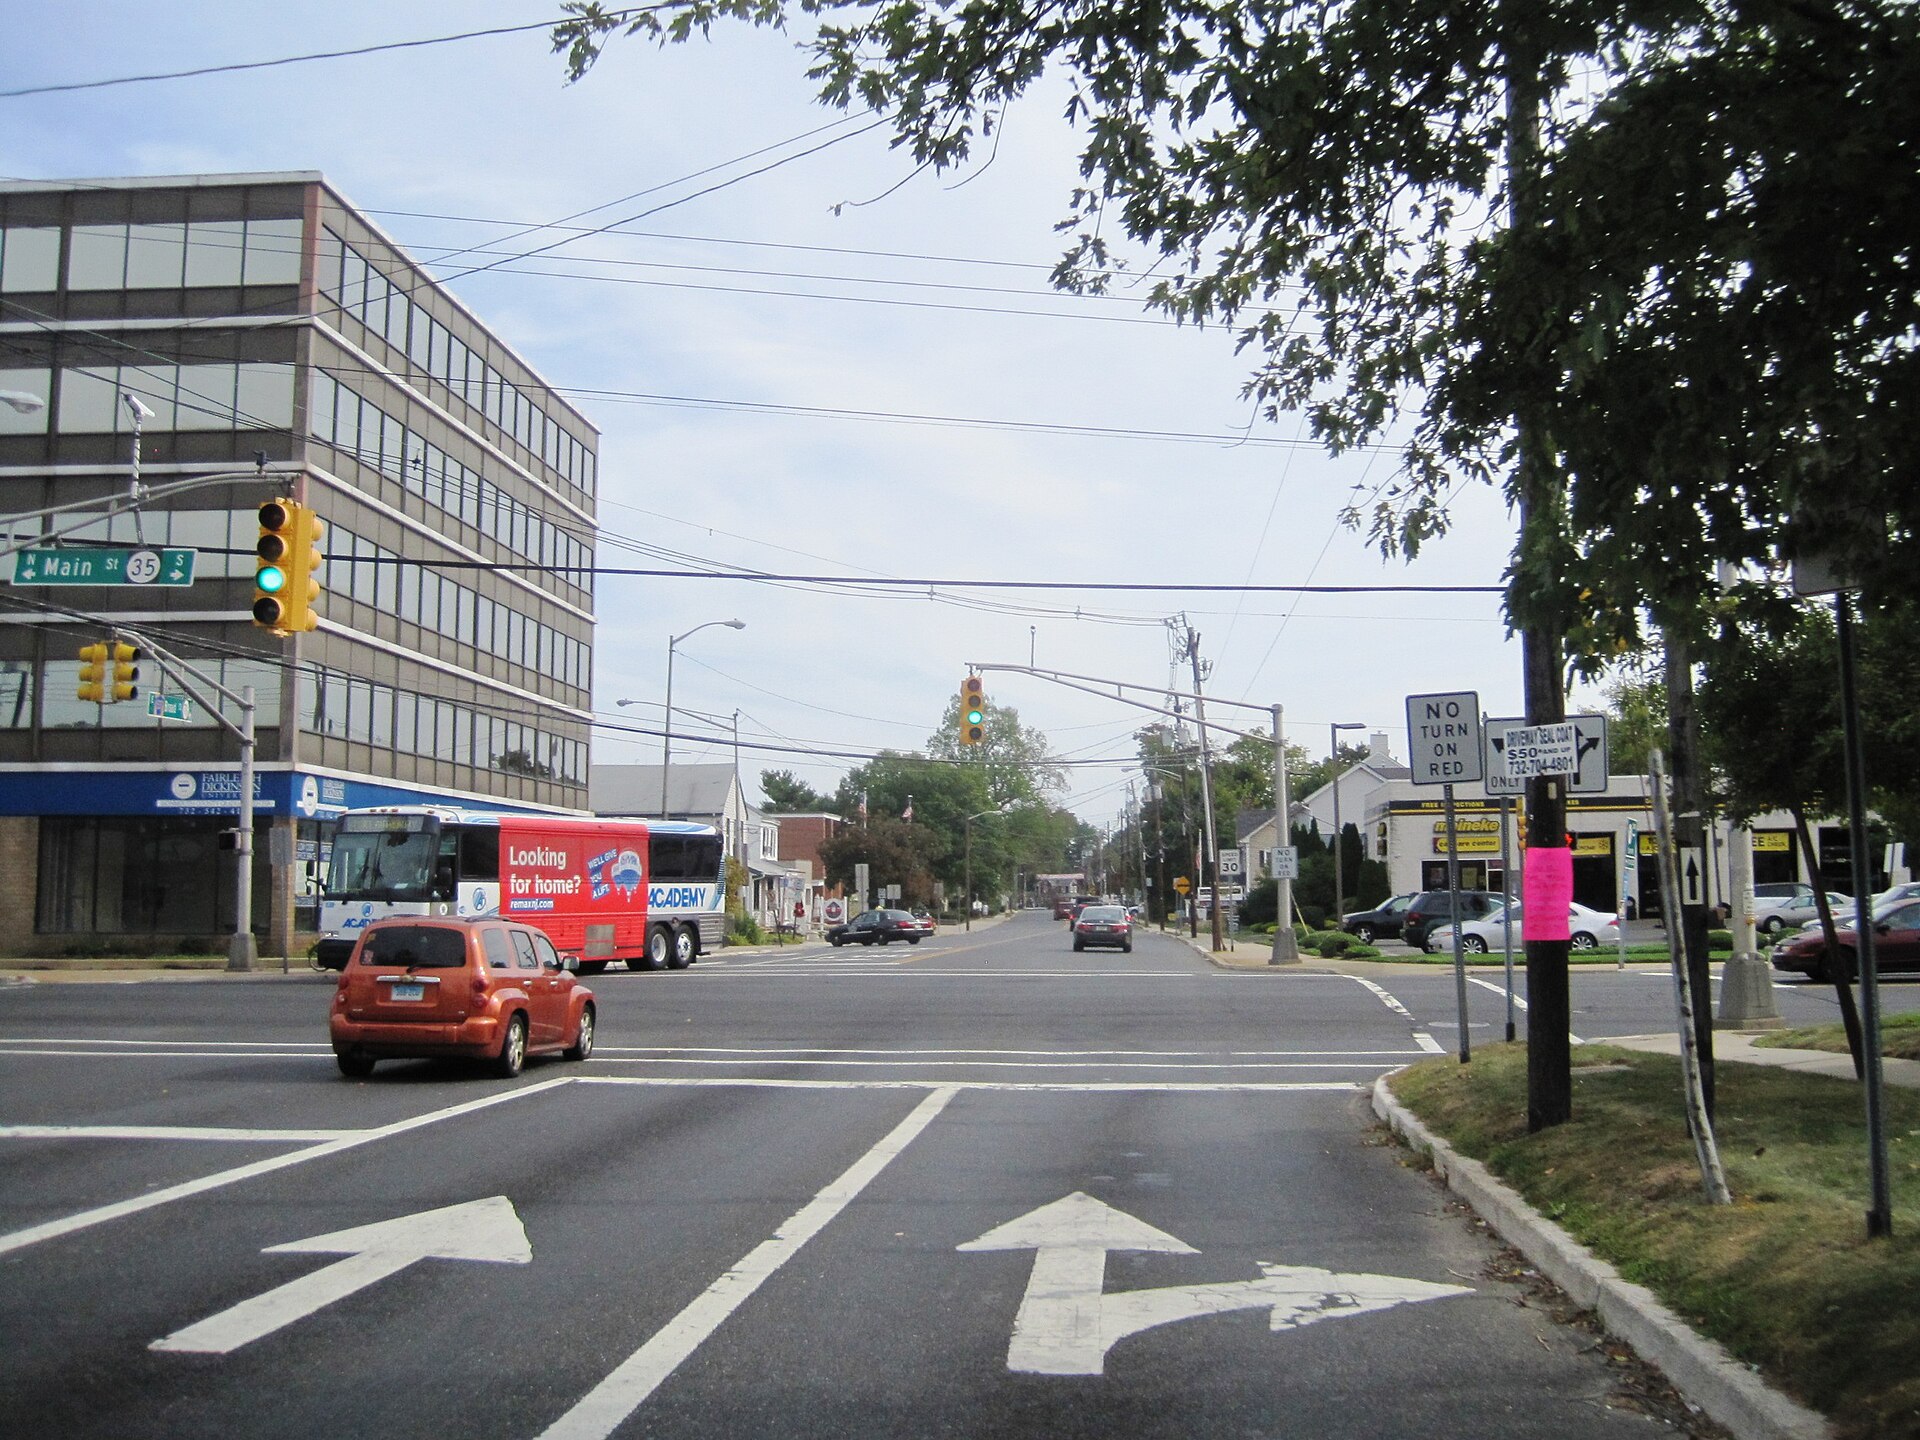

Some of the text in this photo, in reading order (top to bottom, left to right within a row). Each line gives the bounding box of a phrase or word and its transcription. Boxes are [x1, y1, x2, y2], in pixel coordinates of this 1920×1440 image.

[27, 554, 184, 576] N Main St 35 S
[1426, 701, 1460, 719] NO
[1420, 723, 1468, 739] TURN
[1507, 725, 1573, 747] DRIVEWAY SEAL COAT
[1434, 743, 1457, 757] ON
[1430, 761, 1463, 776] RED
[1508, 756, 1574, 775] 732-704-4801
[202, 773, 261, 783] FAIRLEH
[1491, 776, 1520, 788] ONLY
[1434, 819, 1499, 832] mineke
[510, 846, 567, 870] Looking
[1222, 862, 1239, 872] 30
[510, 873, 582, 894] for home?
[510, 899, 554, 910] remaxnj.com
[648, 887, 706, 908] ACADEMY
[342, 918, 373, 928] ACAD
